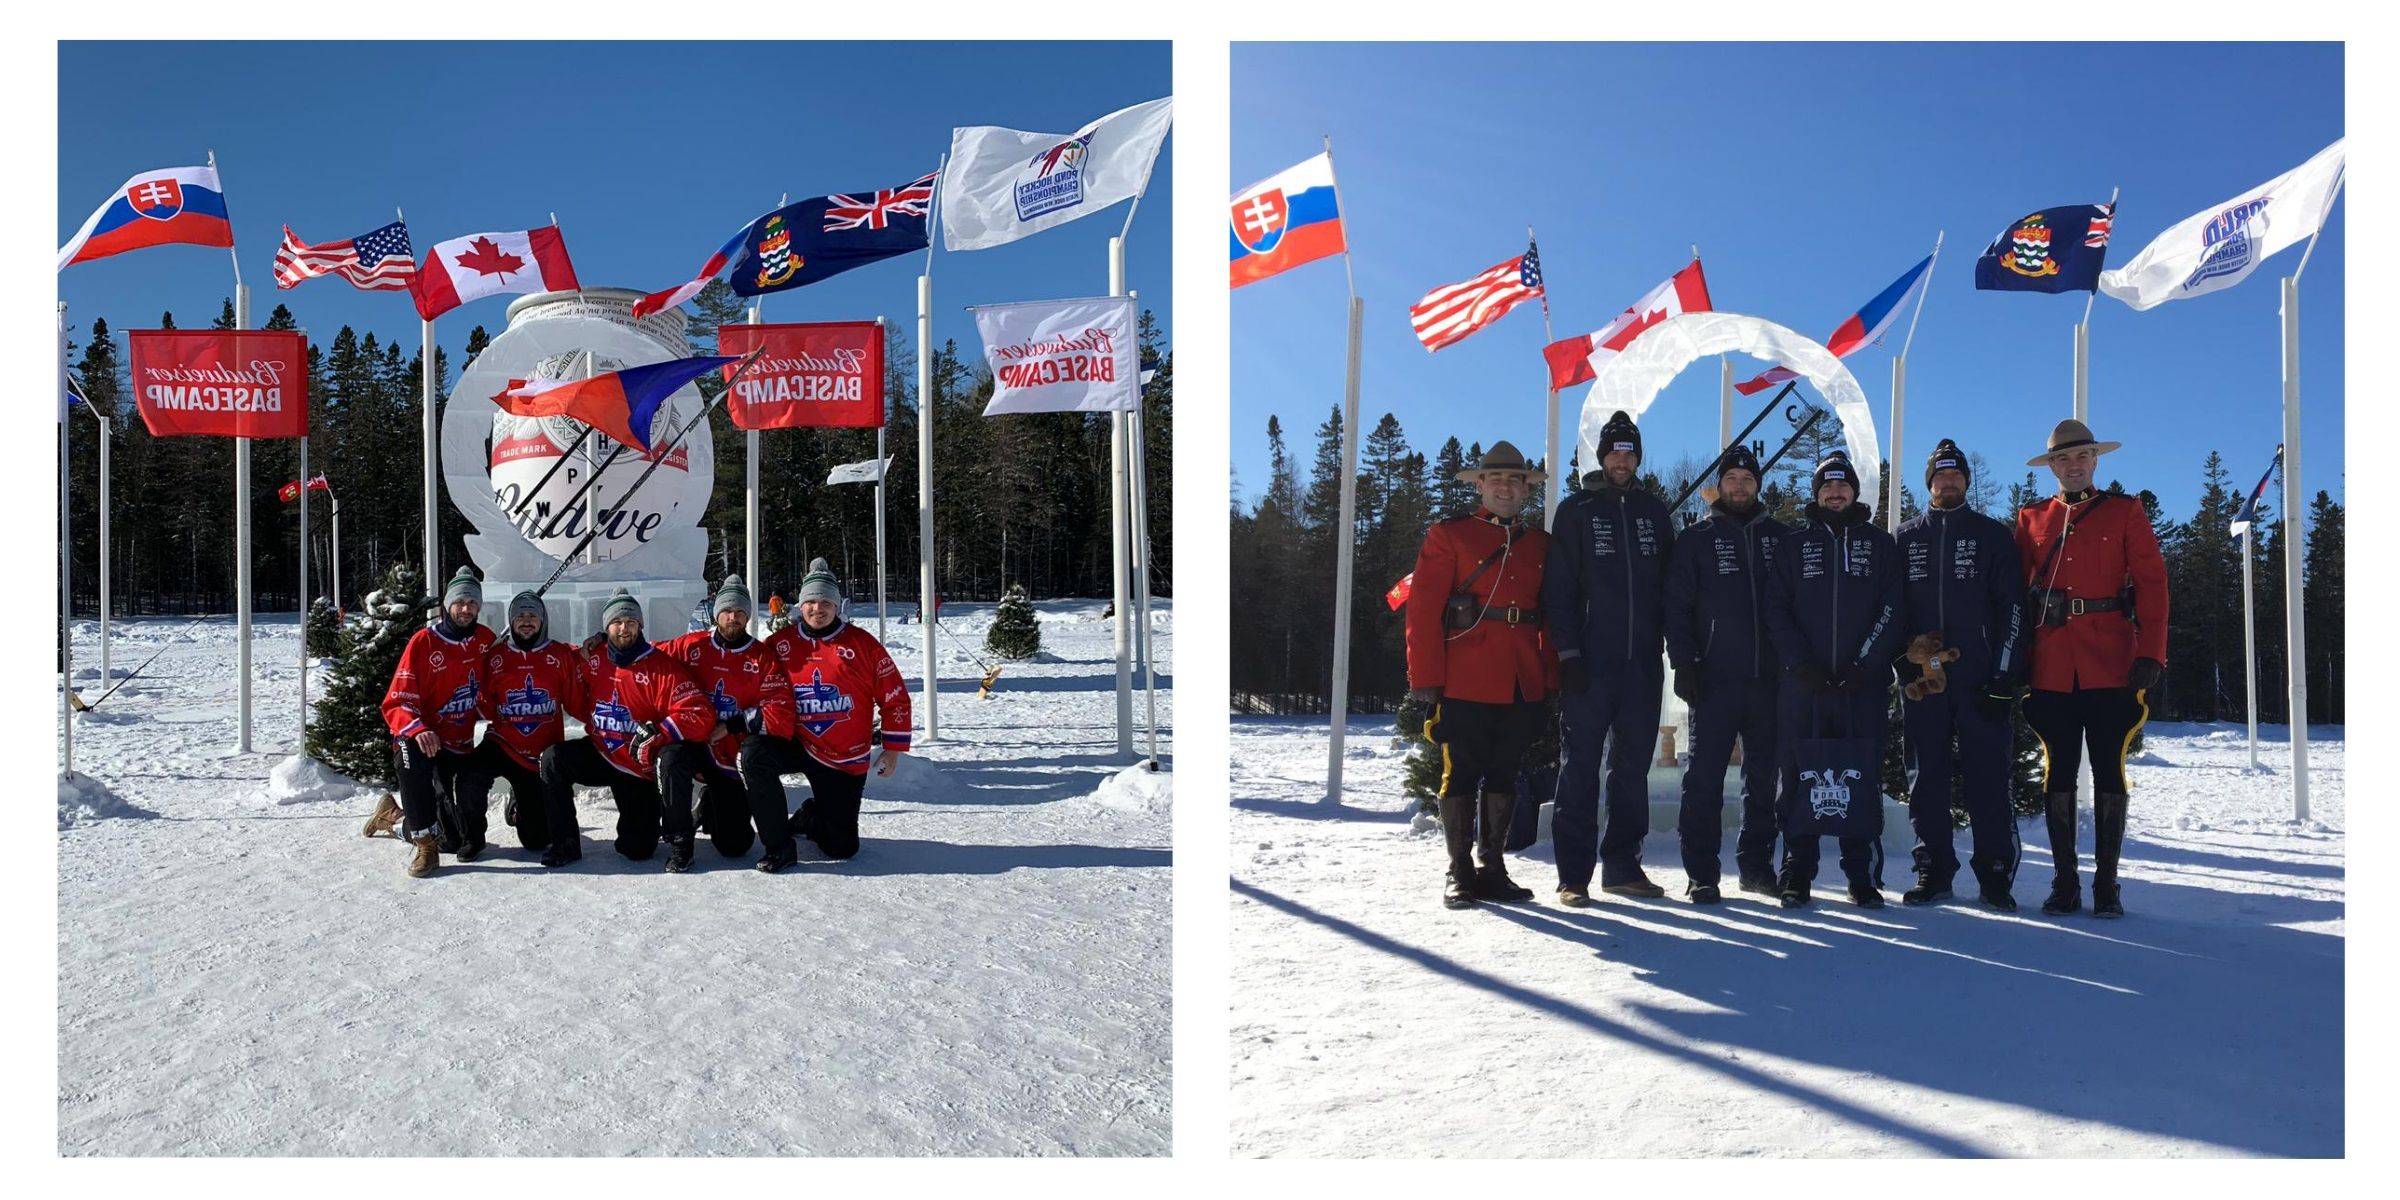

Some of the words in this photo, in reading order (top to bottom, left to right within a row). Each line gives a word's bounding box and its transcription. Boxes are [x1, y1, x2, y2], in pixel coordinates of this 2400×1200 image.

[602, 308, 634, 318] produc
[1785, 404, 1797, 423] C
[599, 434, 610, 450] H
[1752, 440, 1765, 458] H
[500, 446, 519, 459] TRADE
[523, 444, 547, 455] MARK
[568, 468, 578, 484] P
[494, 482, 663, 543] Budwe
[535, 502, 551, 518] W
[1682, 511, 1698, 526] W
[796, 696, 853, 714] STRAVA
[595, 714, 639, 734] STRAVA
[399, 740, 411, 770] AUER
[1813, 790, 1848, 800] WORLD
